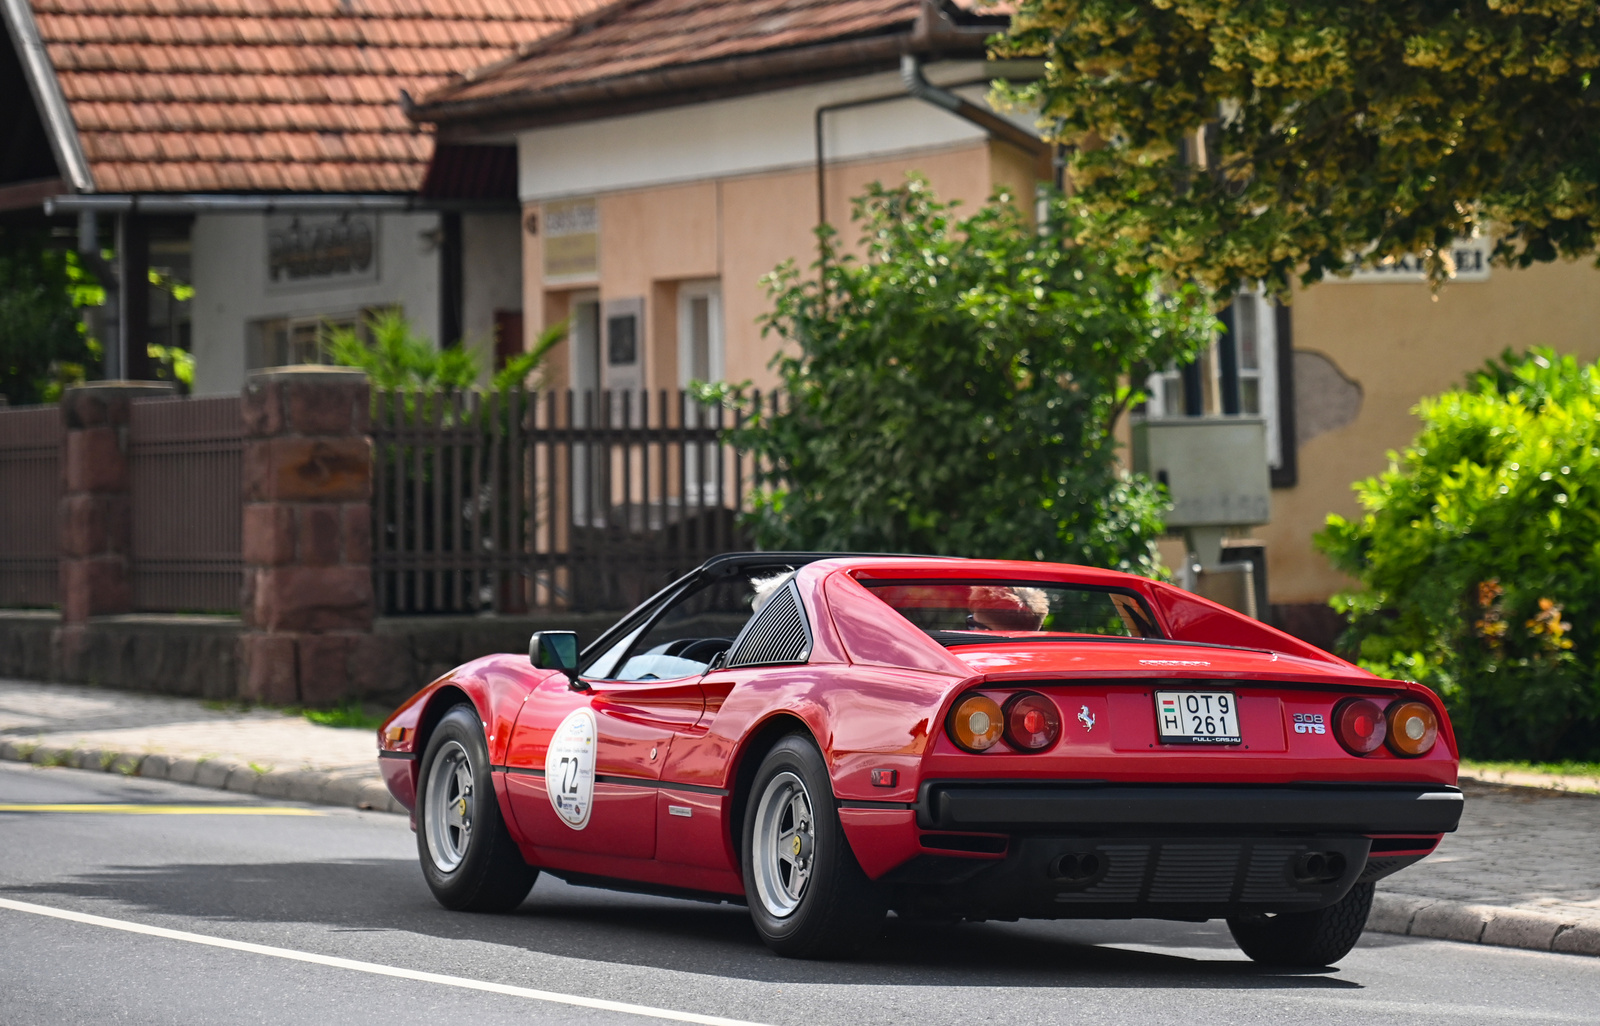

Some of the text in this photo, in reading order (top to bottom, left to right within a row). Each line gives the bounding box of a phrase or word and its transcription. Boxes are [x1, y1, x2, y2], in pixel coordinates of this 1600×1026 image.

[1164, 715, 1178, 729] H
[1192, 716, 1227, 735] 261
[1293, 713, 1324, 724] 308
[1294, 723, 1326, 735] GTS
[560, 757, 578, 794] 72
